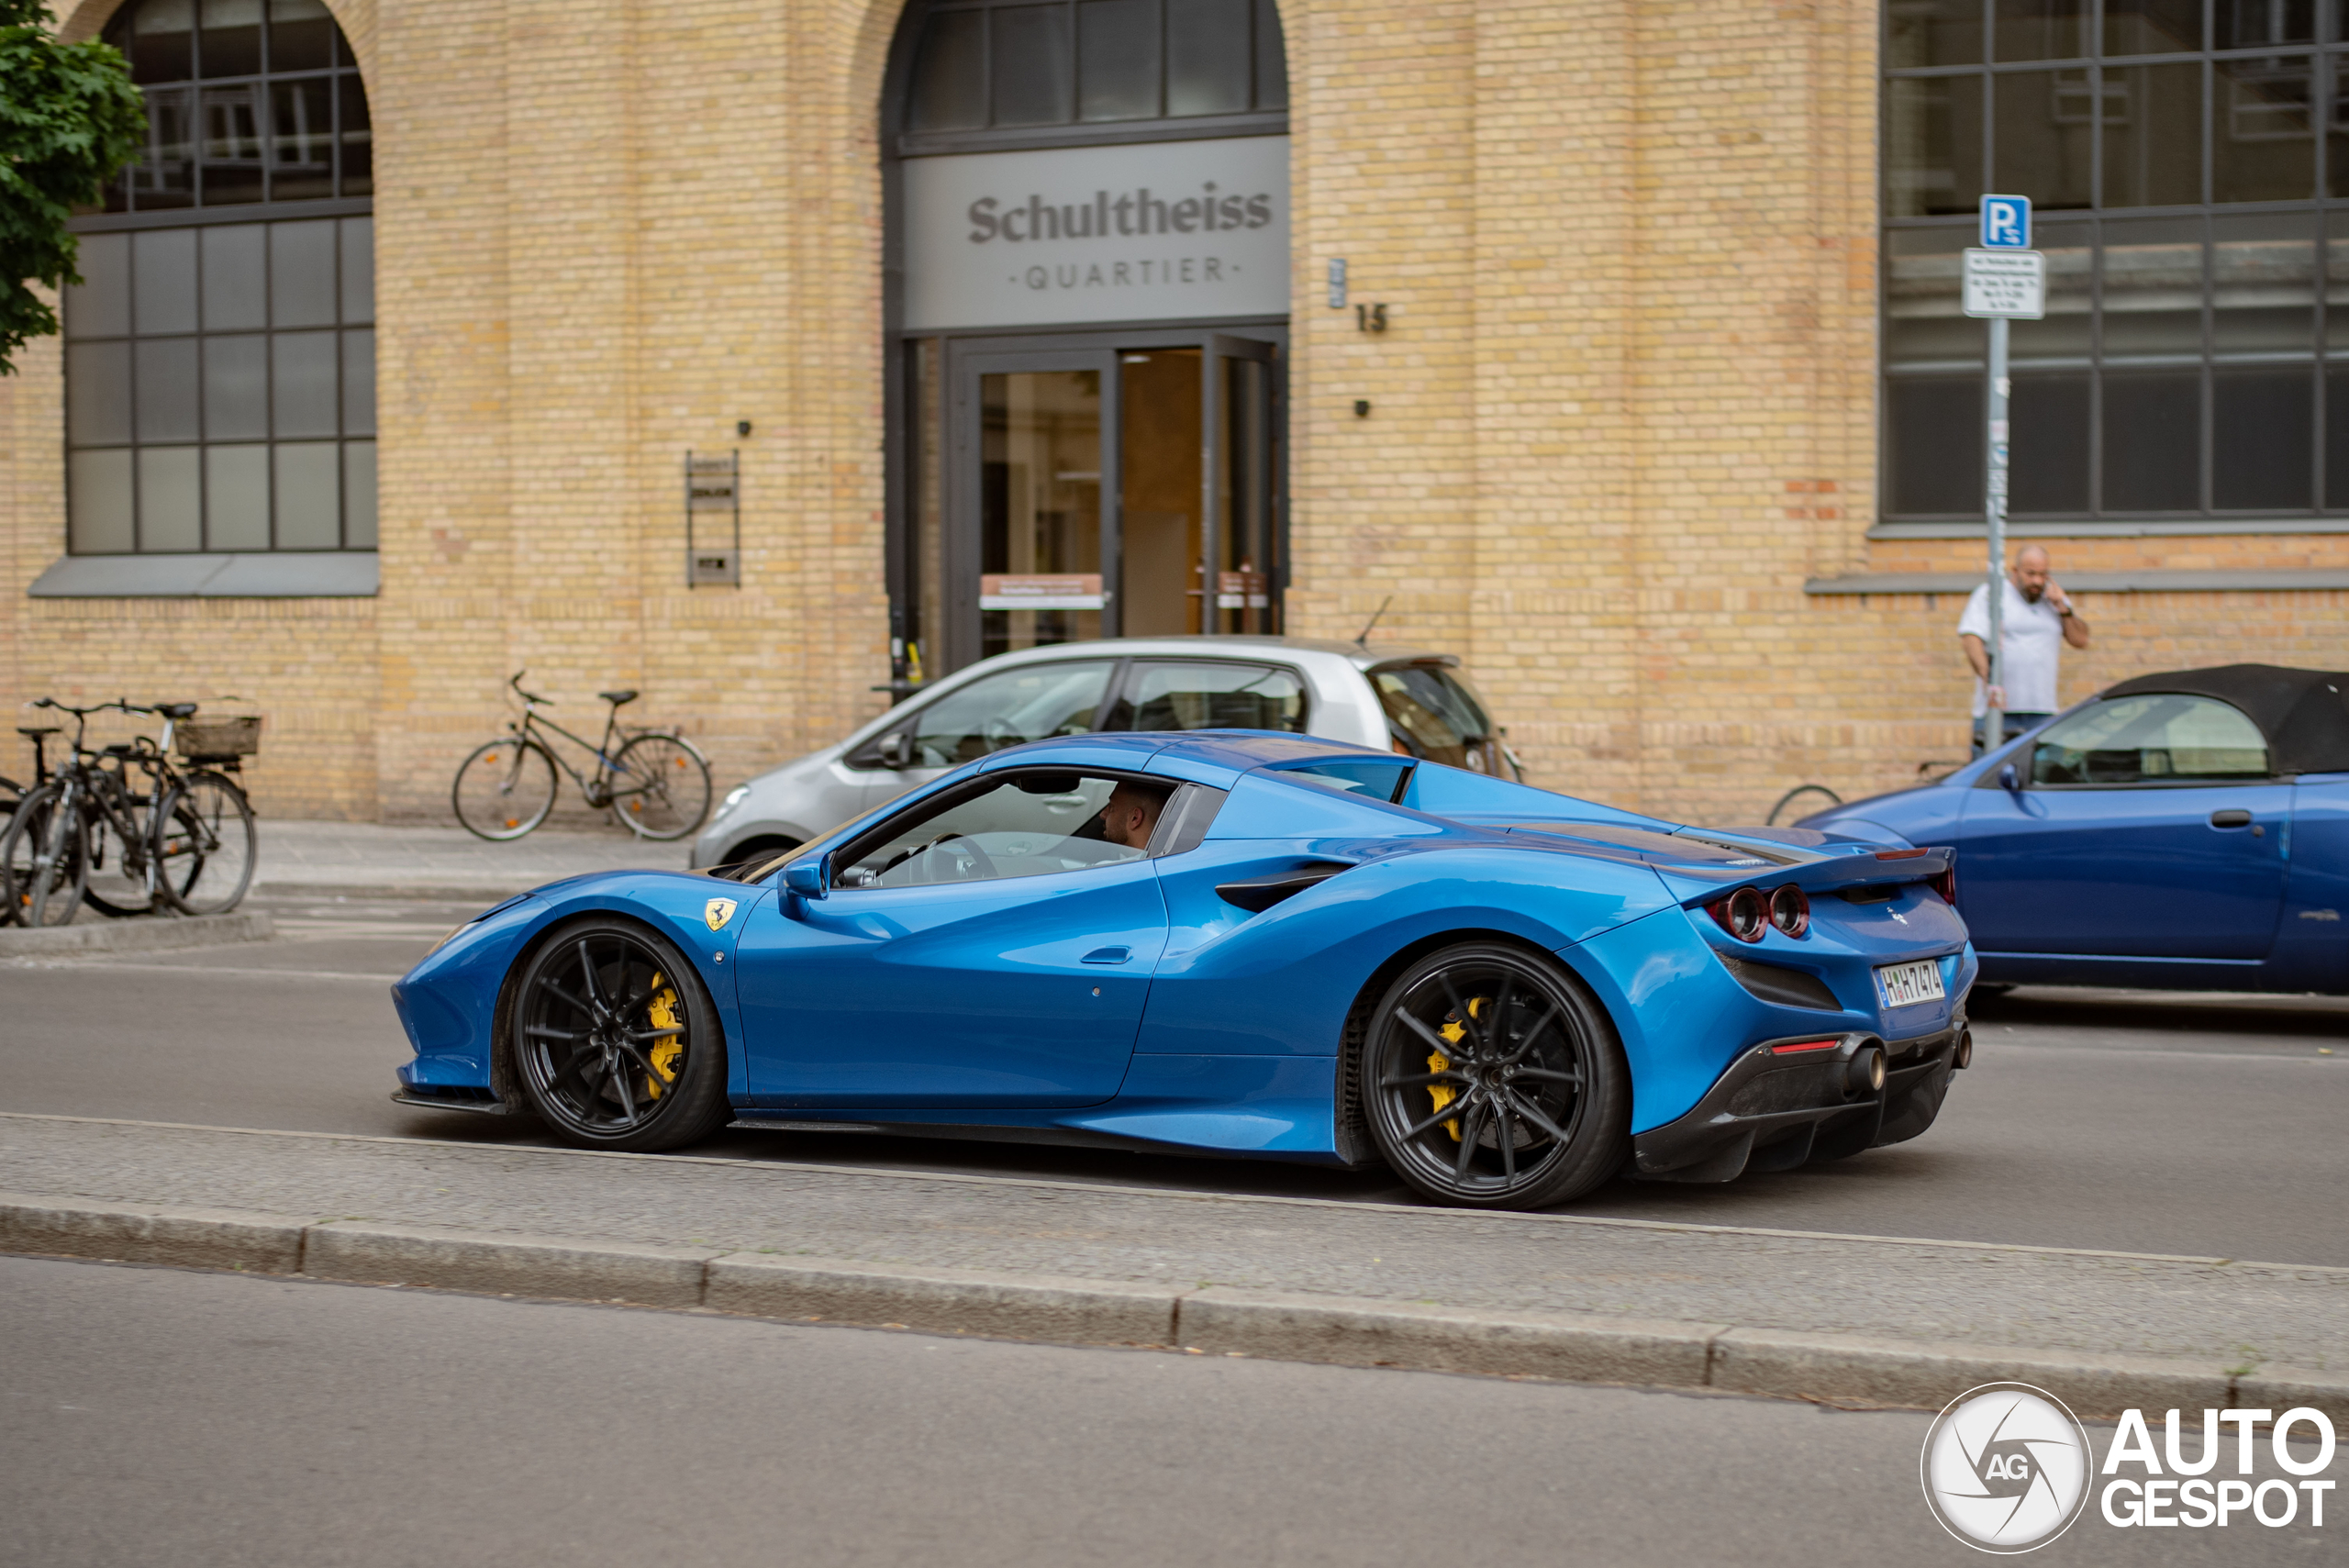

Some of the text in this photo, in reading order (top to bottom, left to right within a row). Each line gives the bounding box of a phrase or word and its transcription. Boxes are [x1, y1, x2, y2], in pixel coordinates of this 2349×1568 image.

[968, 180, 1272, 244] Schultheiss
[1988, 202, 2018, 242] P
[1356, 303, 1387, 331] 15
